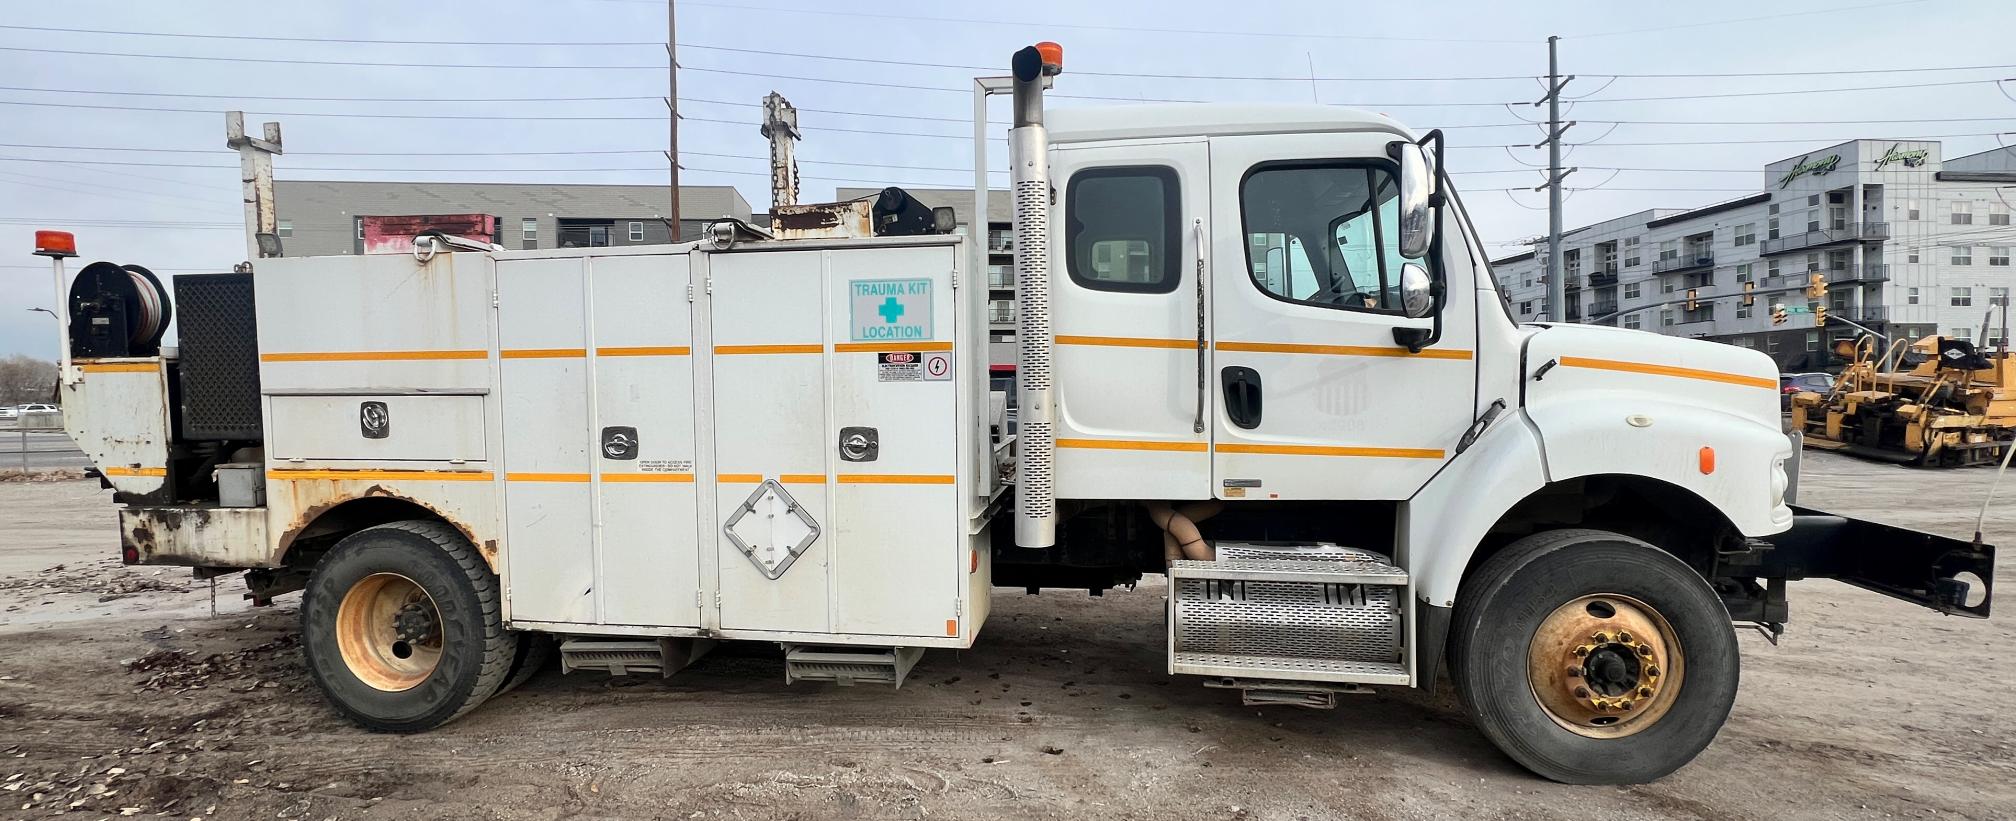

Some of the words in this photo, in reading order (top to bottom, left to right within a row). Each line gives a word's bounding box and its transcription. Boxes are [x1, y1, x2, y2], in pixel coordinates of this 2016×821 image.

[1875, 143, 1929, 171] Harmony
[1780, 155, 1842, 189] Harmony
[856, 283, 904, 296] TRAUMA
[908, 282, 927, 295] KIT
[862, 325, 922, 338] LOCATION
[889, 353, 911, 362] DANGER
